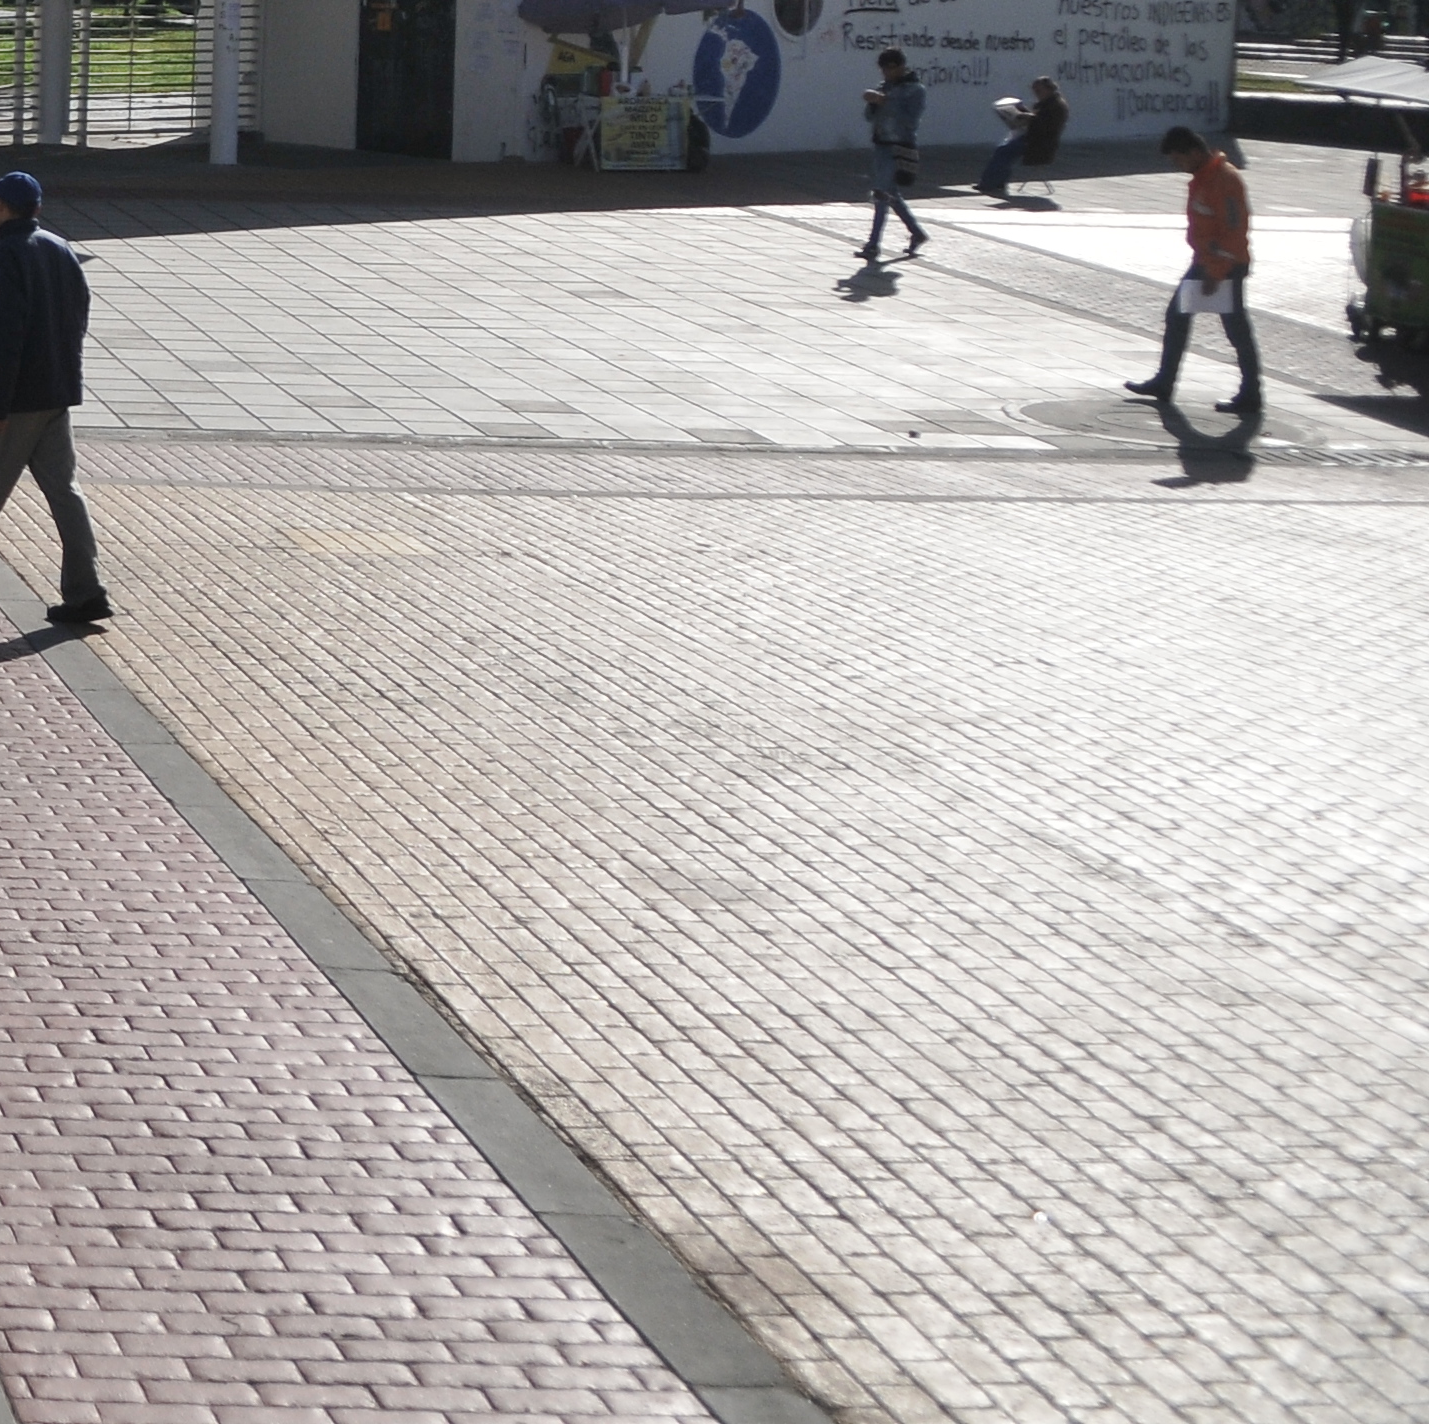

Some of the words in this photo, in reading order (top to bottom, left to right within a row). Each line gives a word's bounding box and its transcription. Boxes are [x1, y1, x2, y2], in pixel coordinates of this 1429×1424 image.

[941, 29, 980, 50] desde
[985, 30, 1035, 52] nuestro
[1054, 23, 1067, 49] el
[1155, 34, 1170, 56] de
[629, 131, 660, 140] TINTO
